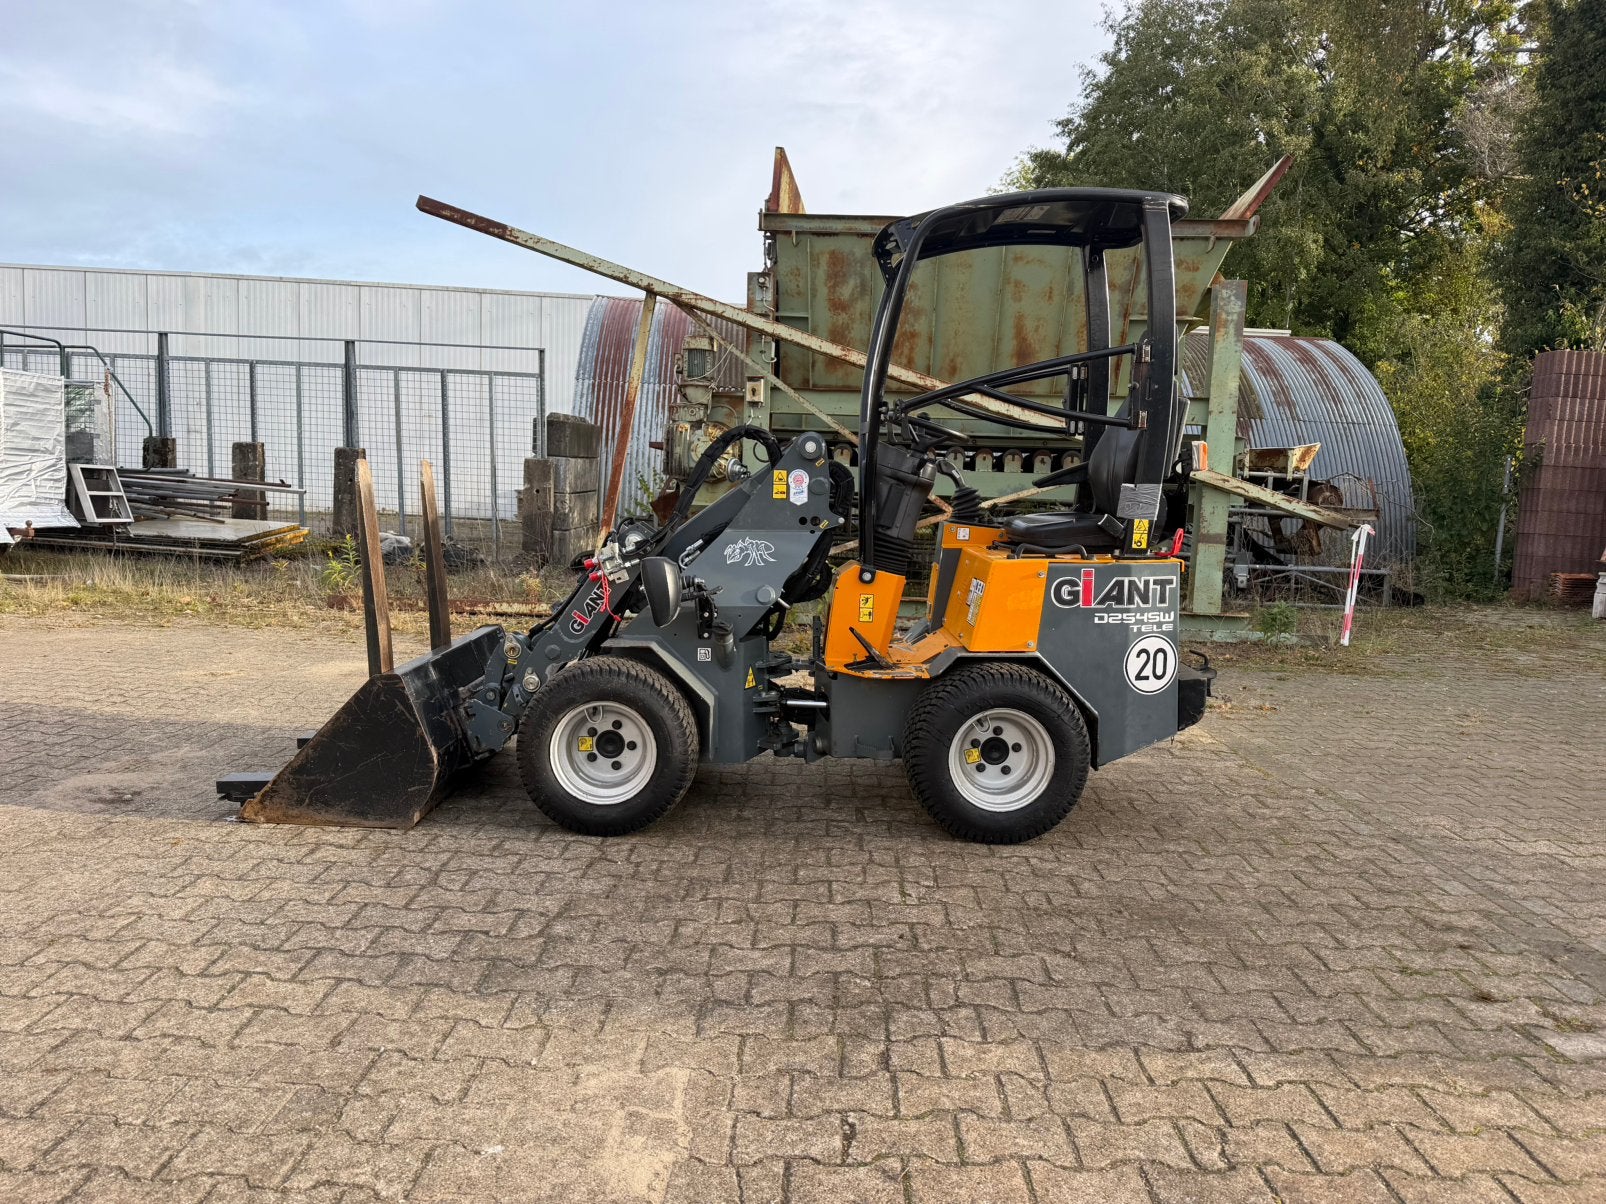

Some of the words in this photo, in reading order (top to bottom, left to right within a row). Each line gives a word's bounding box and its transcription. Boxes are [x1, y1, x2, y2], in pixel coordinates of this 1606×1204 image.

[1094, 611, 1175, 624] D254SW
[1129, 624, 1174, 633] TELE
[1134, 647, 1167, 681] 20
